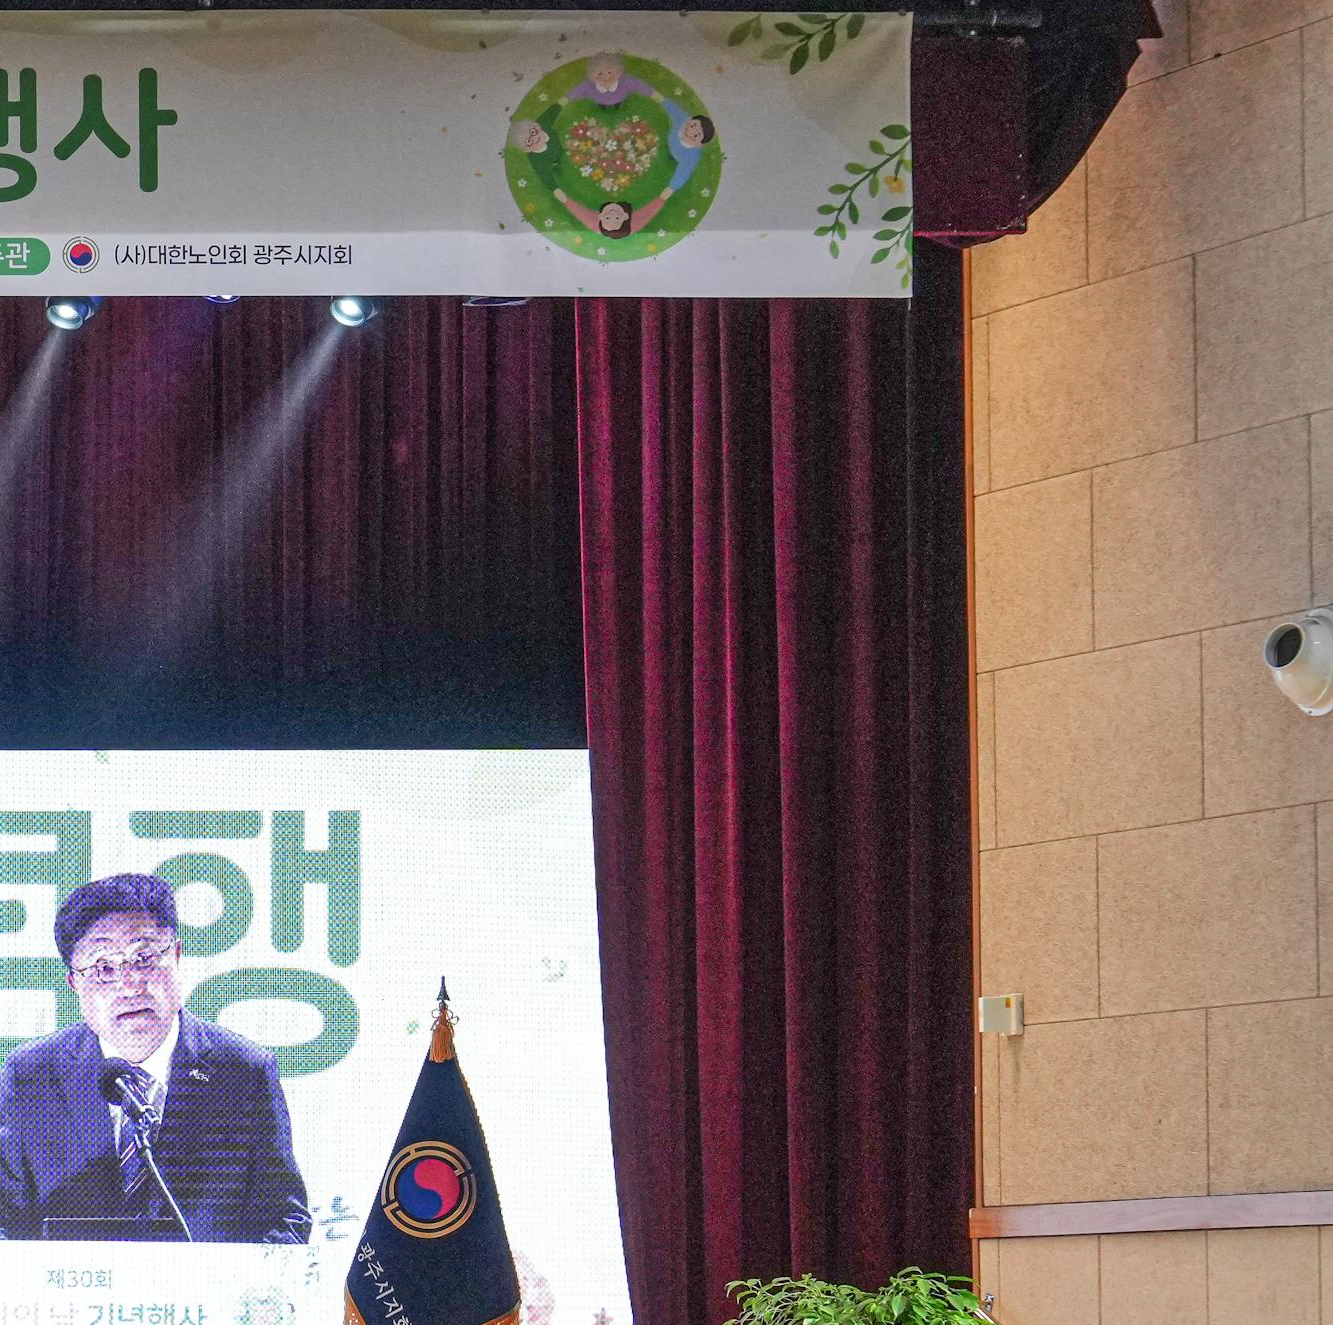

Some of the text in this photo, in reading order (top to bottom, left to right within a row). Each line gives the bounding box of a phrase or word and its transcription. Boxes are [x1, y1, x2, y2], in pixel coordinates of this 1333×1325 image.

[114, 243, 352, 267] (사)대한노인회 광주시지회
[46, 1268, 114, 1290] 제30회
